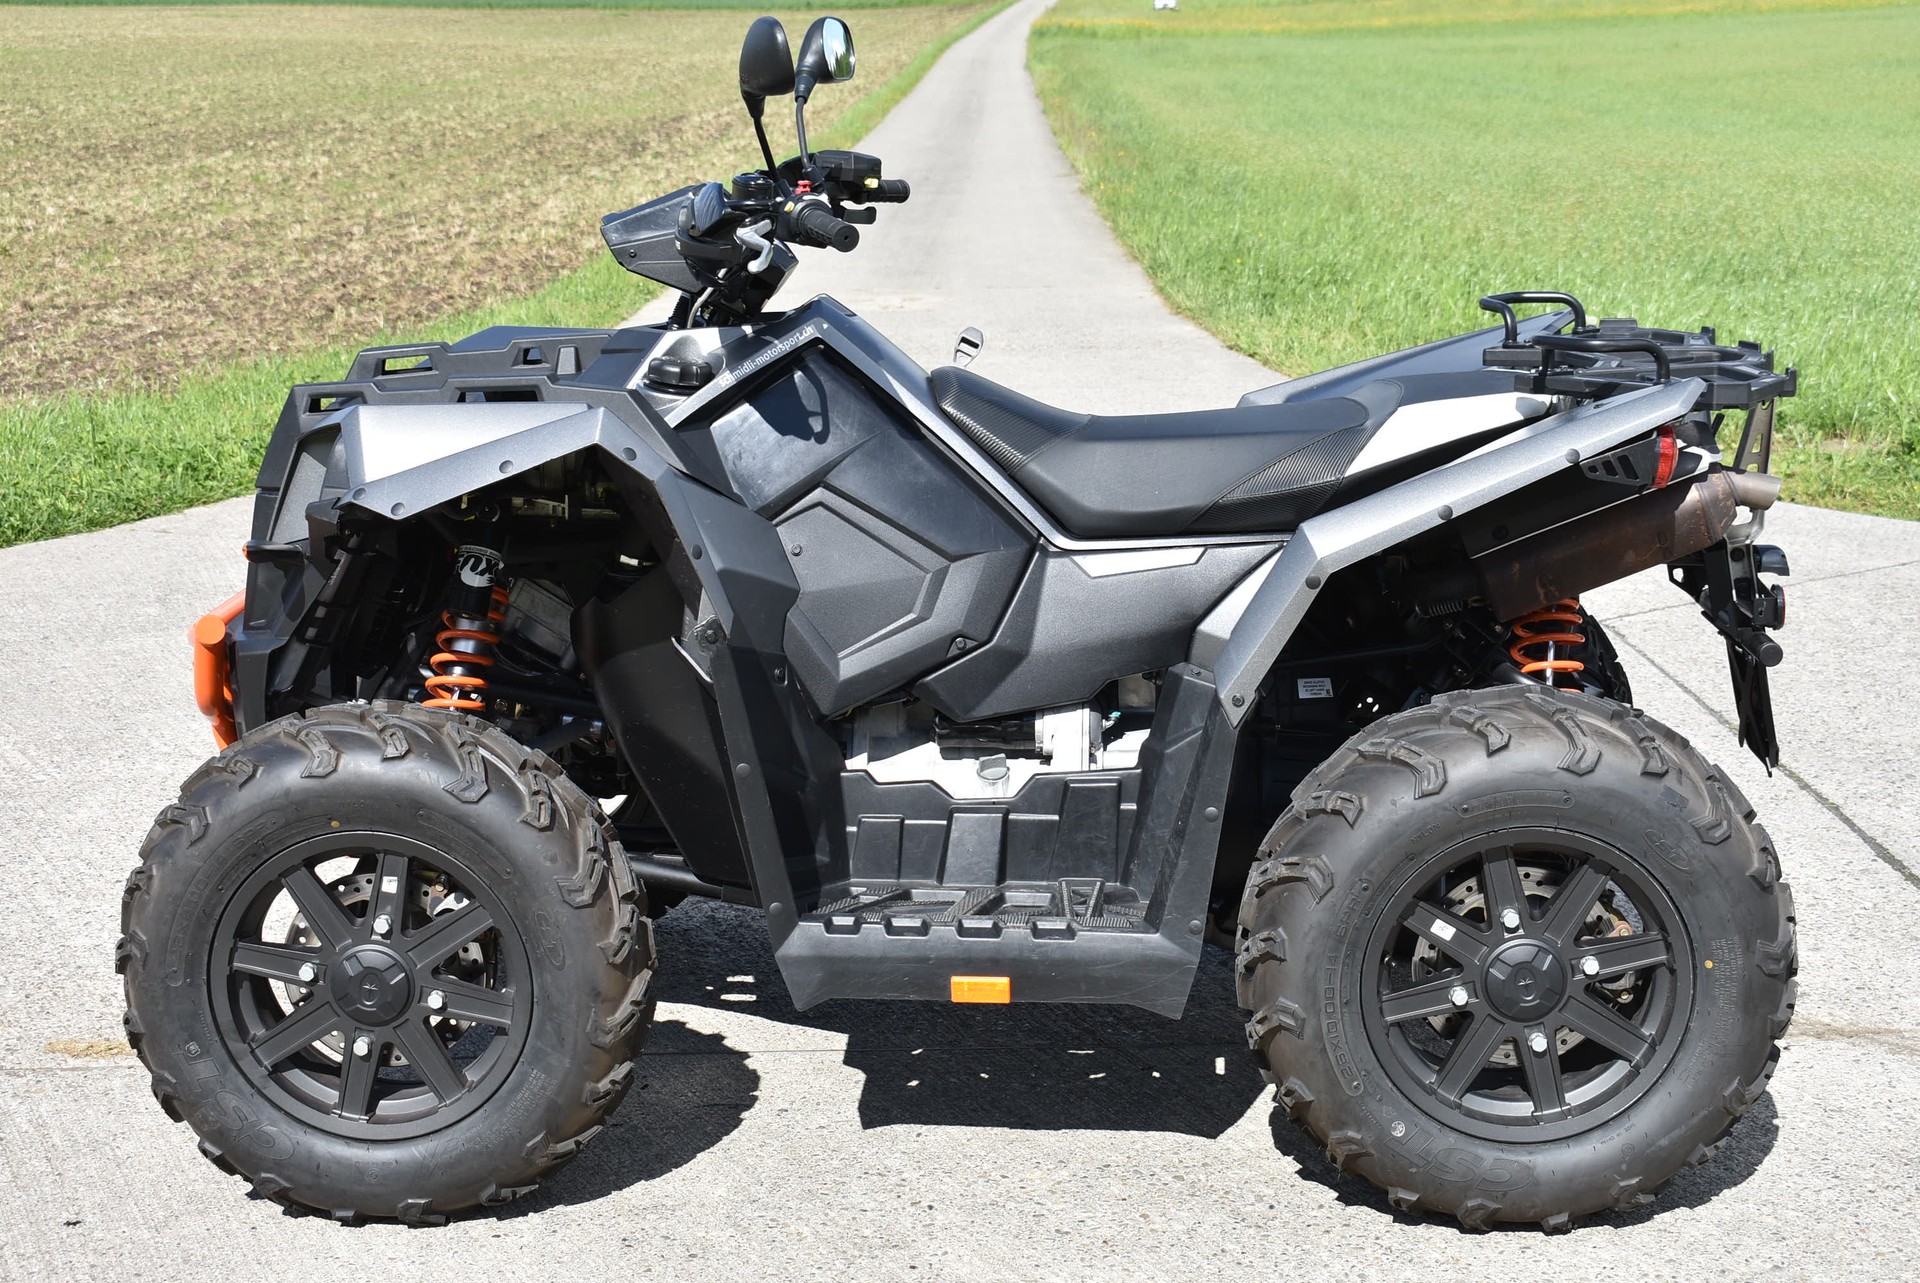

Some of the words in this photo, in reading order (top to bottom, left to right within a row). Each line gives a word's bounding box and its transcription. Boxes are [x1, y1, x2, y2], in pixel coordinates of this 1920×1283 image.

[718, 325, 814, 388] schmidli-motorsport.ch
[1324, 953, 1355, 1079] 26X10.00-14
[172, 1051, 296, 1160] CST
[1384, 1127, 1534, 1192] CST
